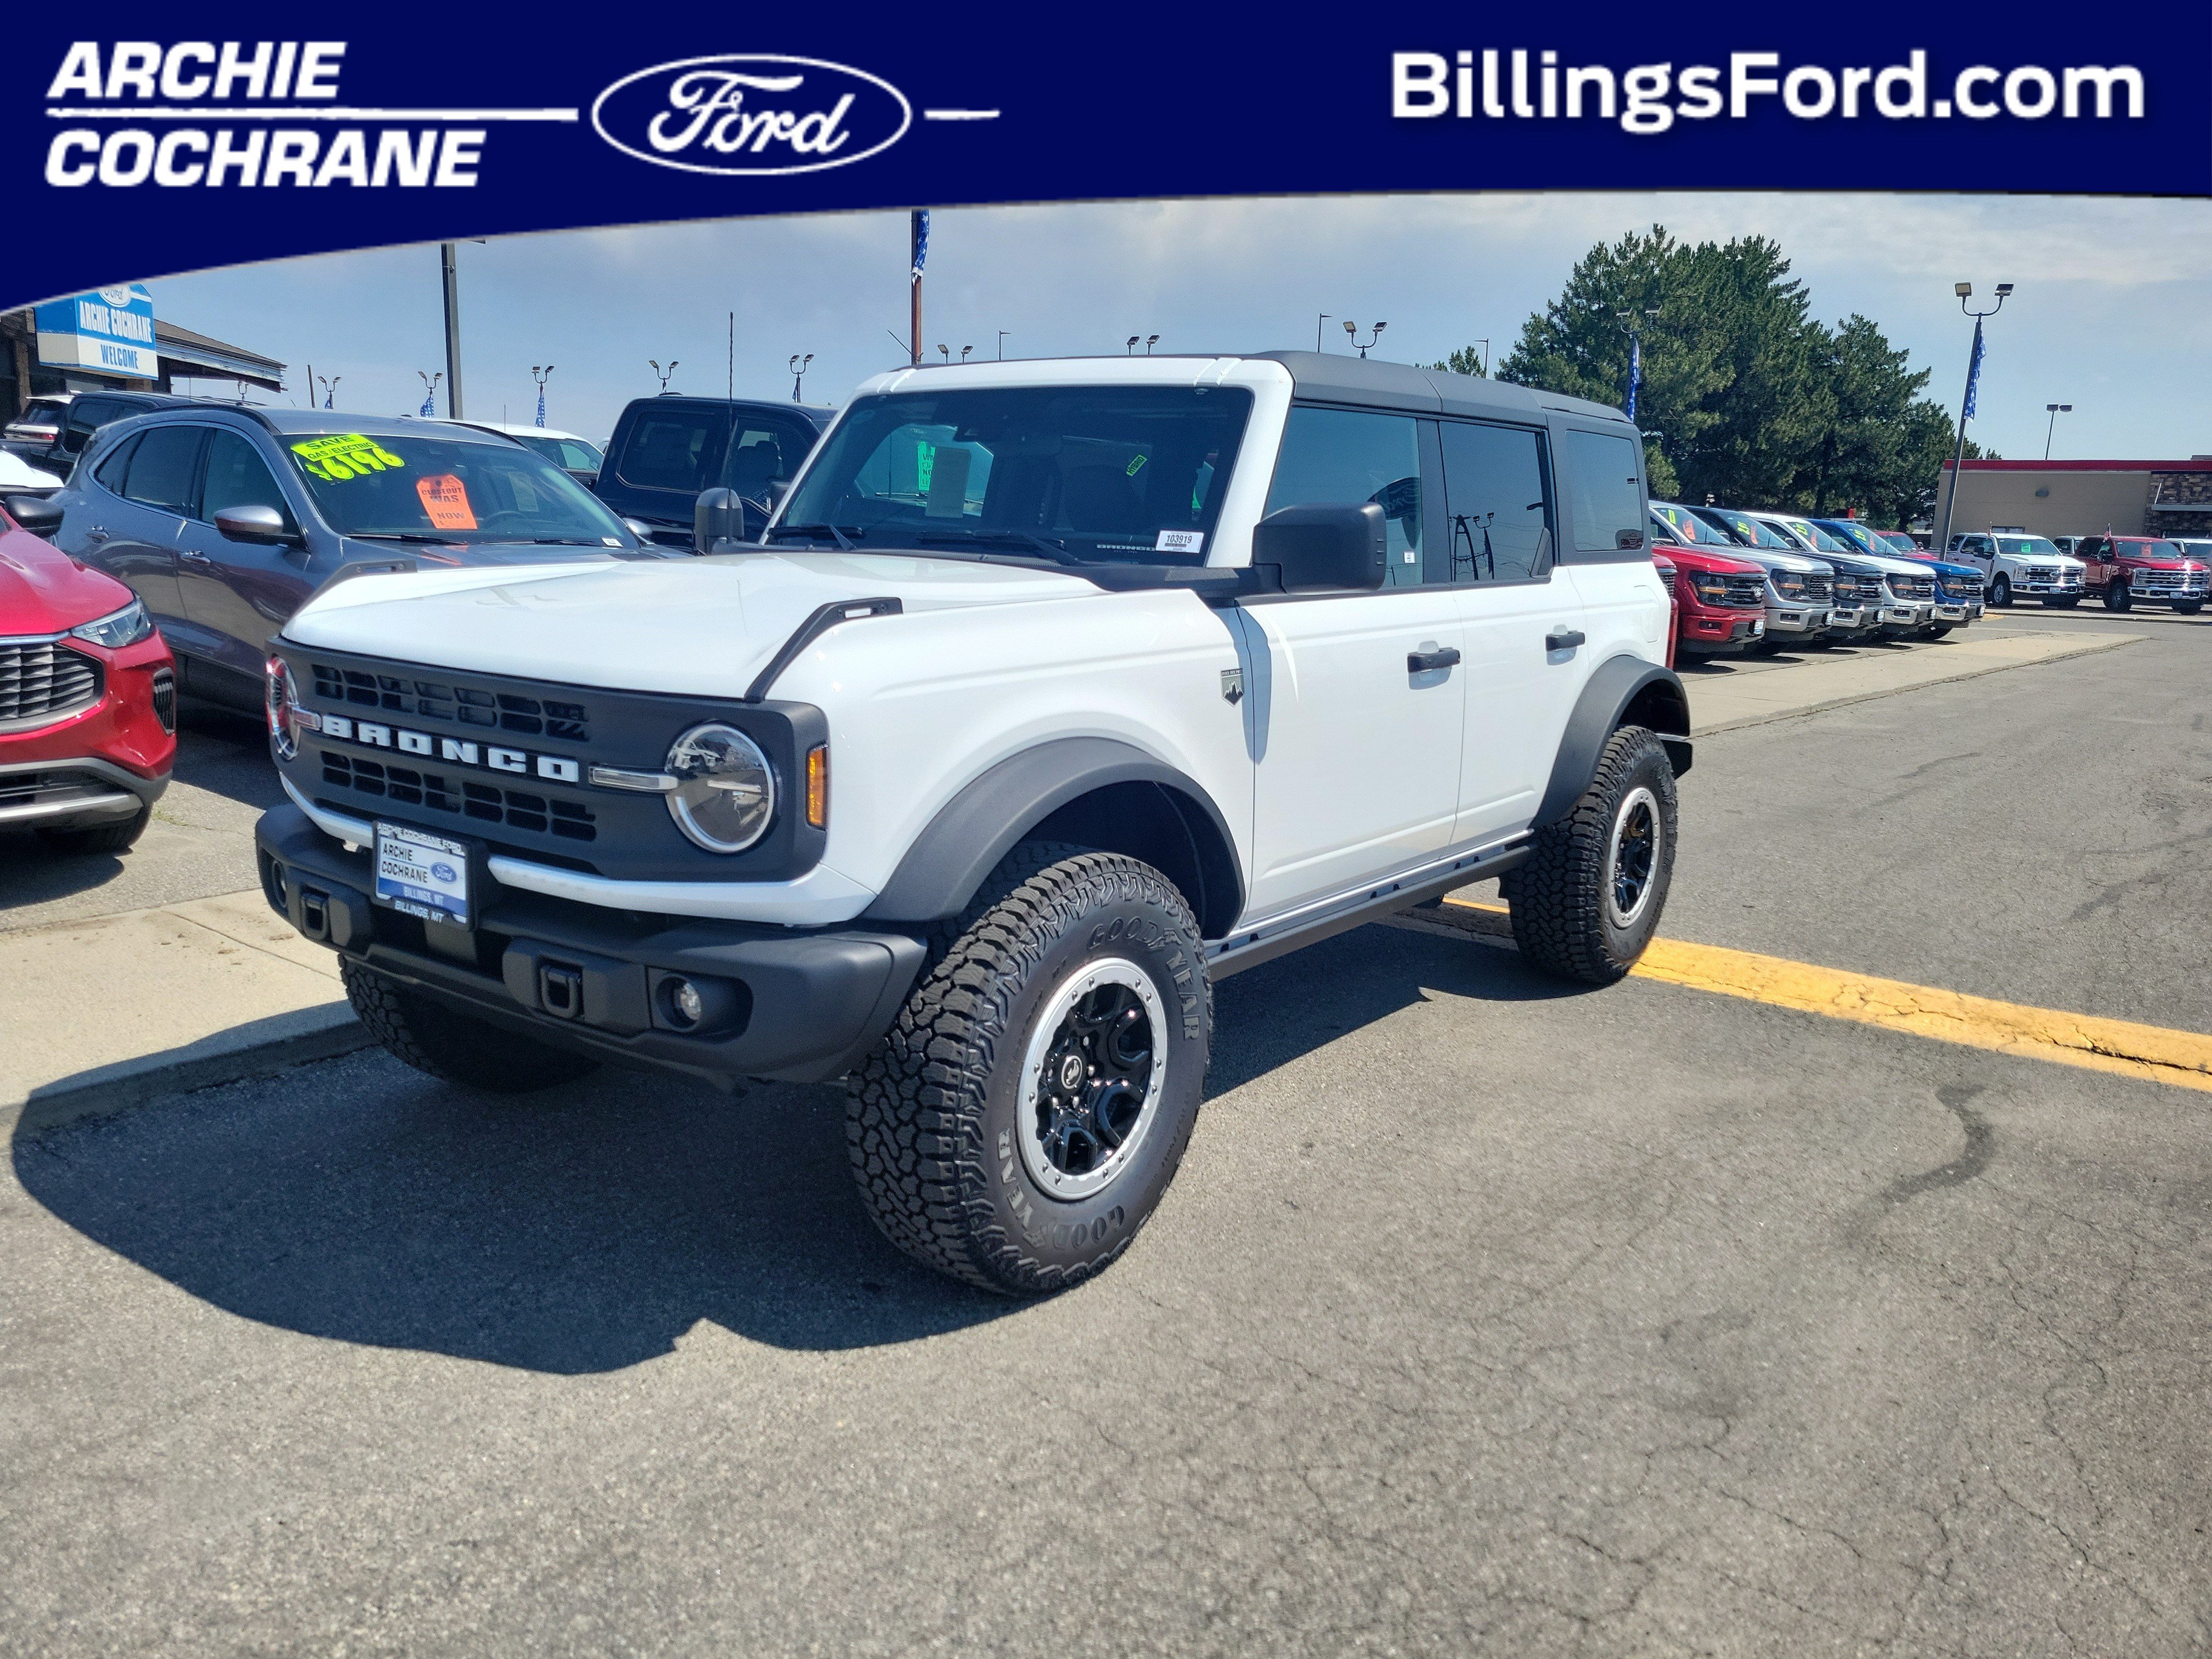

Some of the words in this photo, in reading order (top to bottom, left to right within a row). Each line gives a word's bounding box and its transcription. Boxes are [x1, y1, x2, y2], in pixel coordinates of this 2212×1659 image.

[80, 301, 111, 334] ARCHIE
[110, 308, 153, 343] COCHRANE
[100, 344, 138, 369] WELCOME
[306, 436, 356, 450] SAVE
[305, 448, 405, 481] $6196
[1127, 456, 1144, 475] HYBRID
[430, 495, 459, 503] WAS
[1167, 534, 1193, 544] 103919
[323, 714, 579, 782] BRONCO
[383, 843, 413, 861] ARCHIE
[382, 861, 428, 883] COCHRANE
[435, 865, 452, 881] Ford
[431, 910, 444, 923] MT
[1087, 916, 1200, 1040] GOODYEAR
[997, 1128, 1125, 1249] GOODYEAR
